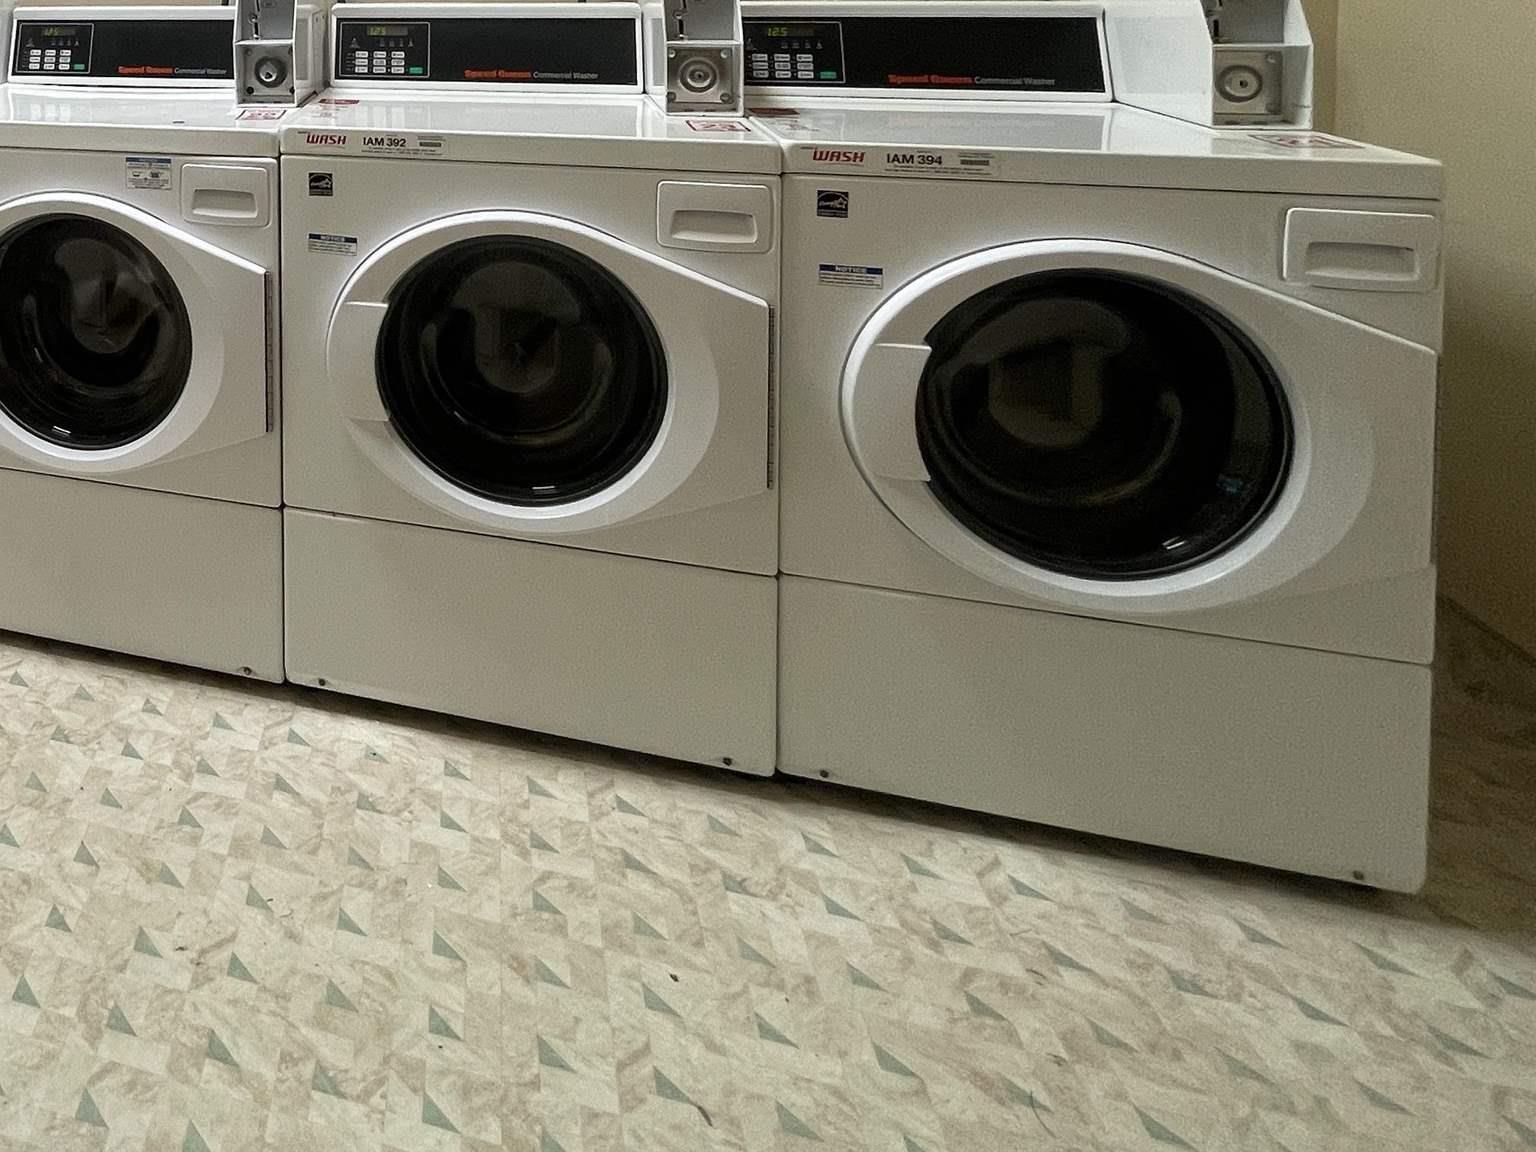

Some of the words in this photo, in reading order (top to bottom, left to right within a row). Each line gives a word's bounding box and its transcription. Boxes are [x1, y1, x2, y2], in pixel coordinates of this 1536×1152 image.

[306, 134, 346, 145] WASH
[363, 136, 384, 146] IAM
[386, 137, 406, 148] 392
[813, 150, 865, 163] WASH
[887, 153, 914, 164] IAM
[917, 154, 943, 165] 394
